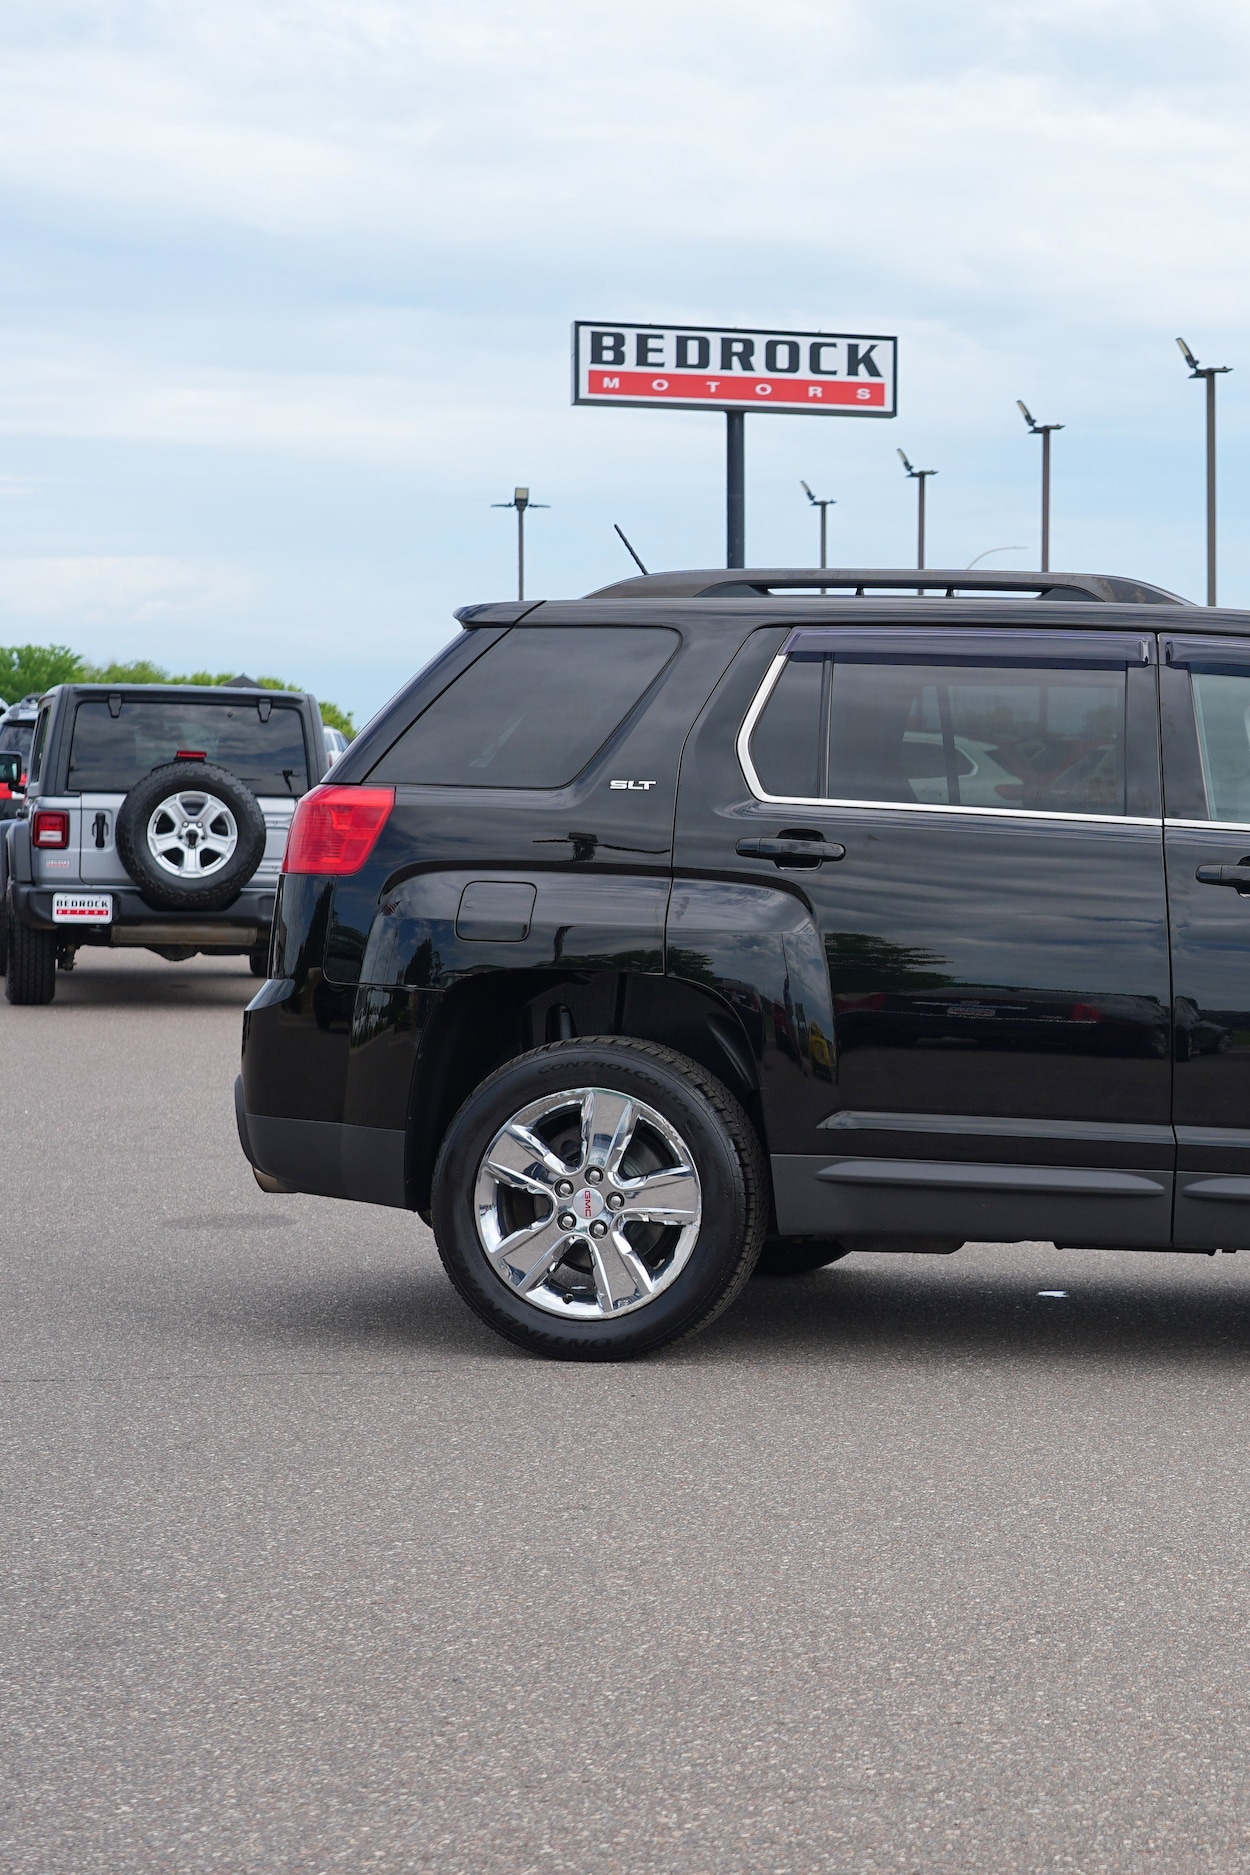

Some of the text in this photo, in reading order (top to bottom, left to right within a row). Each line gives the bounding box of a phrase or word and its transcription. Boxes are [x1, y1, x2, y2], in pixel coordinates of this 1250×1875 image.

[590, 331, 883, 377] BEDROCK
[602, 376, 872, 400] MOTORS
[610, 780, 657, 790] SLT
[56, 900, 108, 908] BEDROCK
[584, 1190, 592, 1217] GMC
